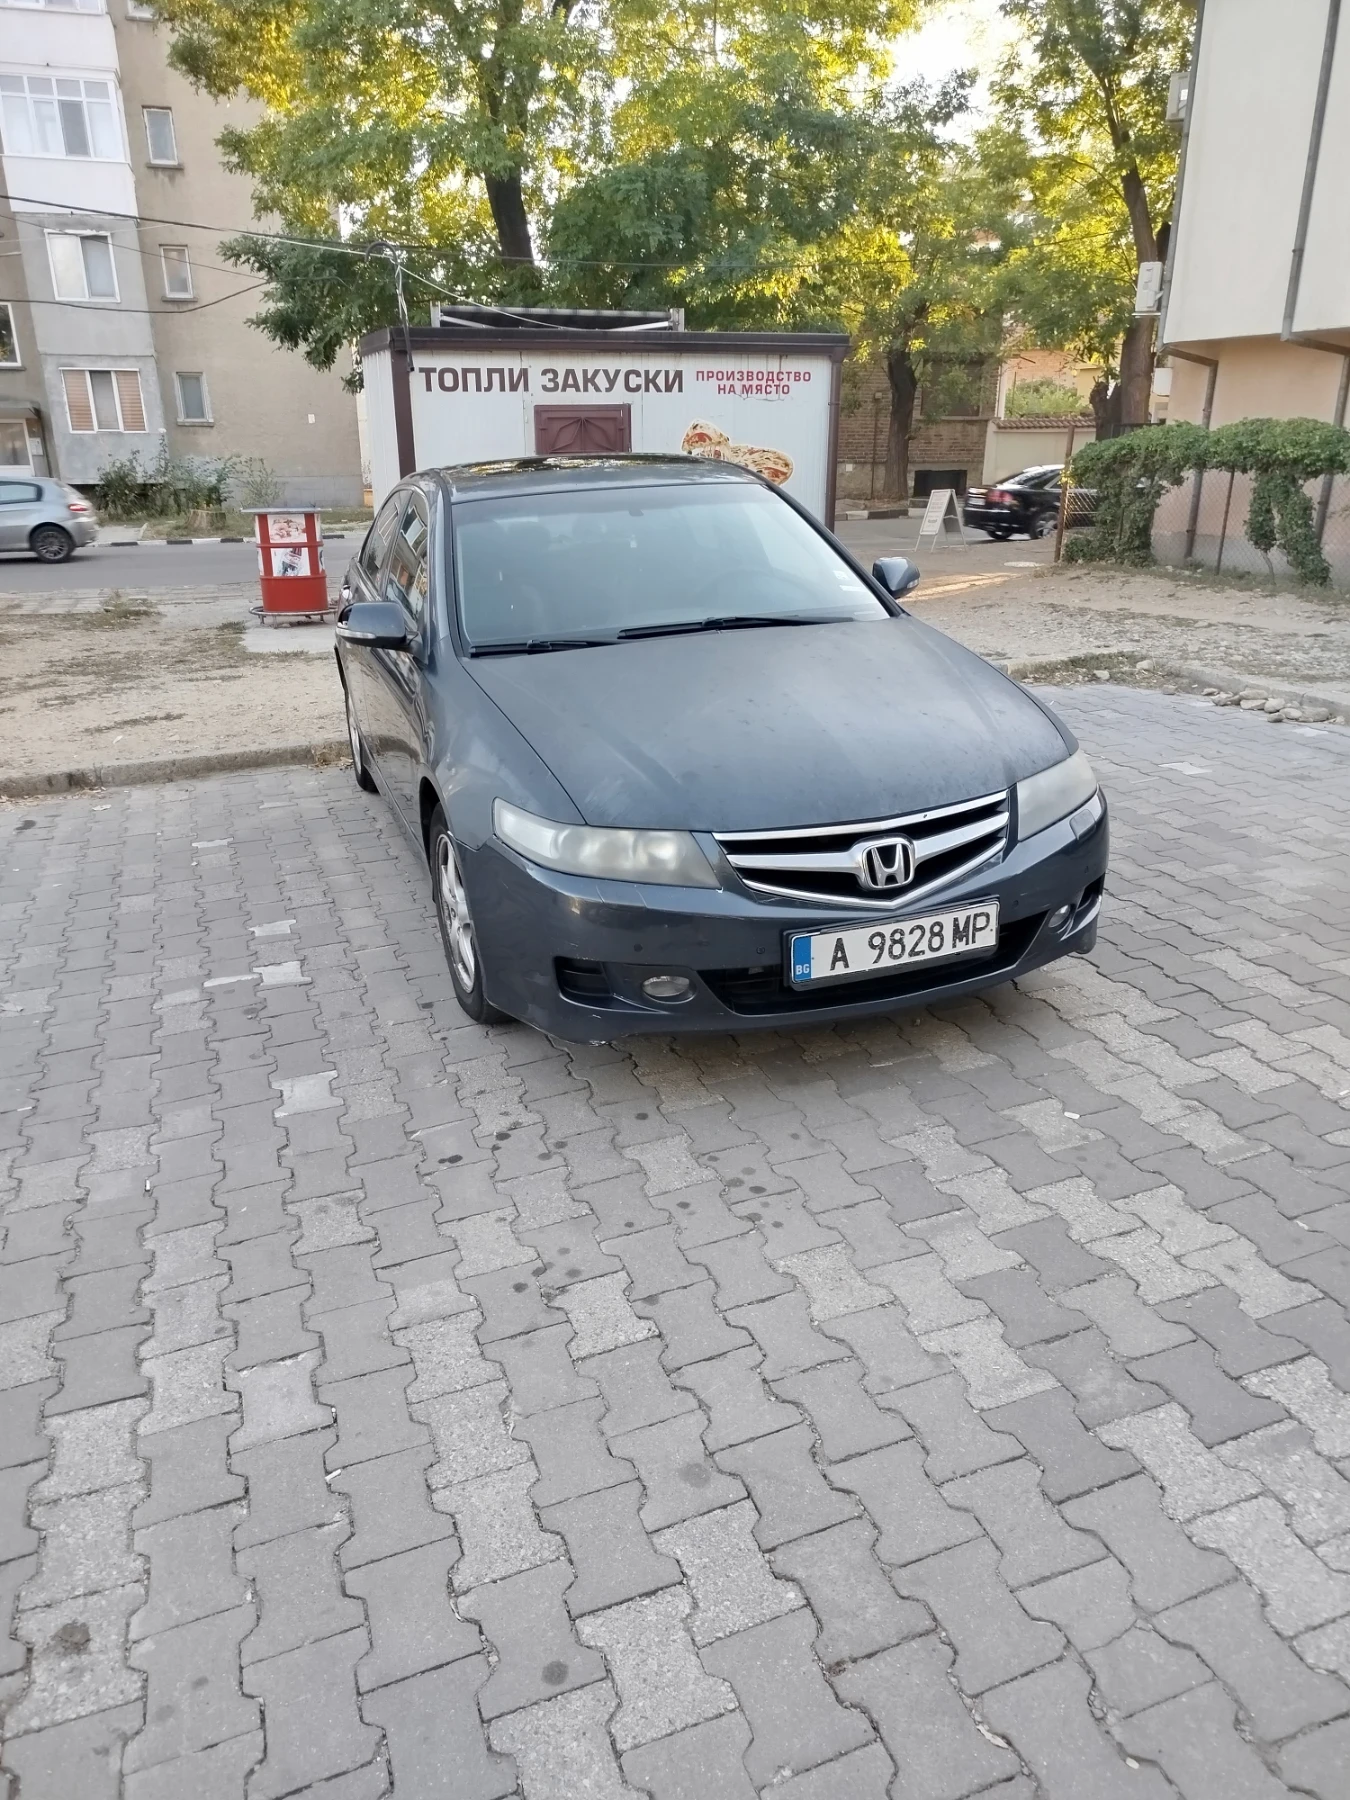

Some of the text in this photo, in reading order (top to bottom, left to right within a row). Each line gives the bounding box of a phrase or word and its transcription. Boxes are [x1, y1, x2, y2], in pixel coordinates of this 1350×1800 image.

[418, 367, 683, 393] ТОПЛИ ЗАКУСКИ
[696, 370, 812, 384] ПРОИЗВОДСТВО
[717, 384, 791, 395] НА МЯСТО
[829, 911, 991, 971] A 9828 MP
[795, 963, 810, 976] BG
